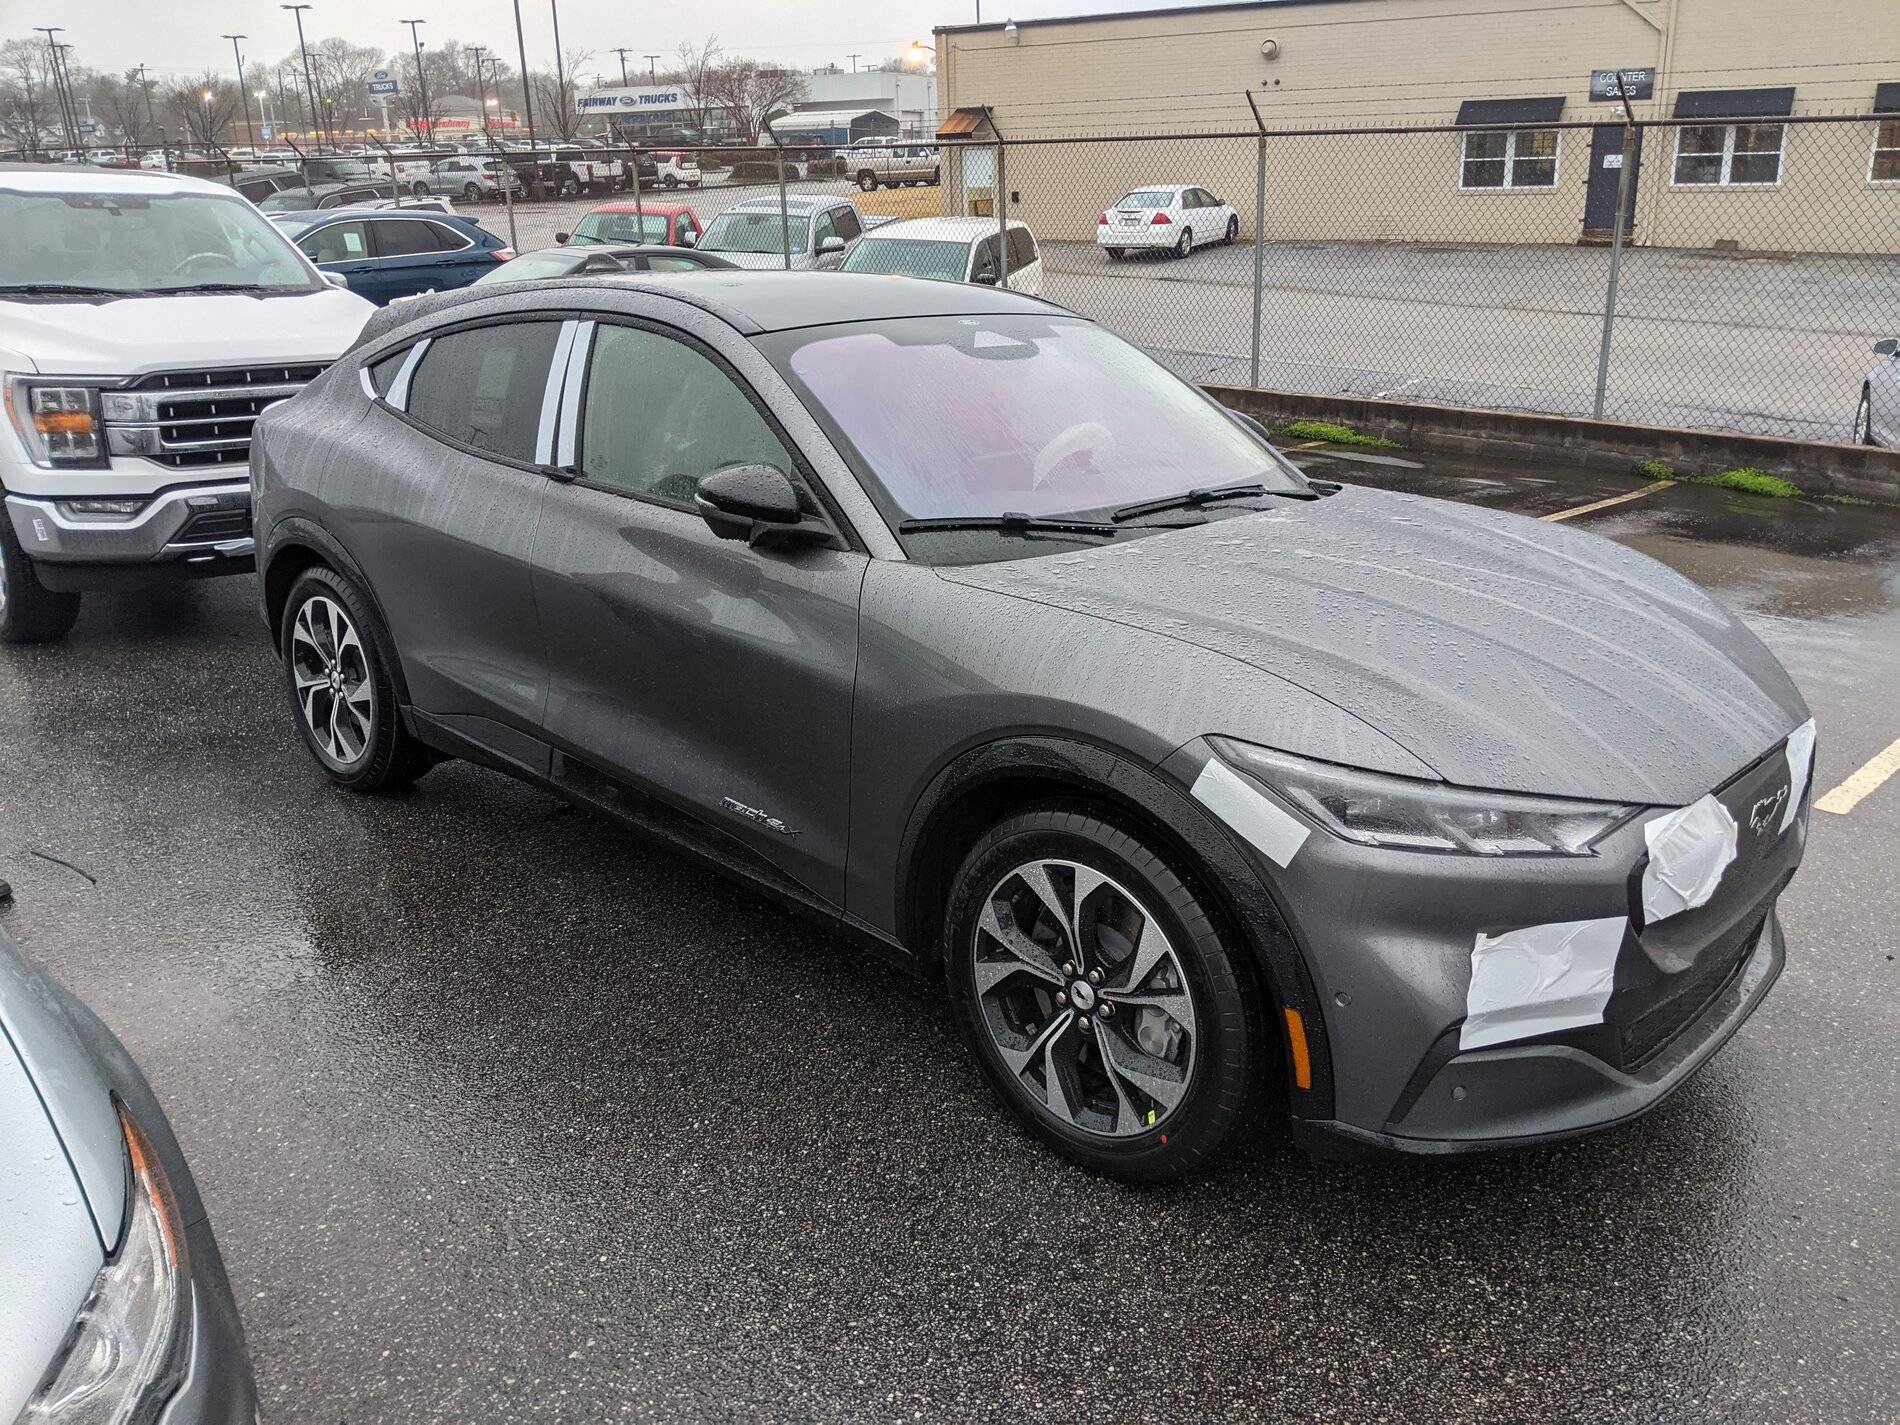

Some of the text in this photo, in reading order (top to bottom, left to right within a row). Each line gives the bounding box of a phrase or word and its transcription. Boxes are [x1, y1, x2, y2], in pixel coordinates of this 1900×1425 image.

[1600, 71, 1646, 82] COUNTER
[372, 82, 394, 91] TRUCKS
[577, 95, 618, 107] FAIRWAY
[638, 93, 678, 105] TRUCKS
